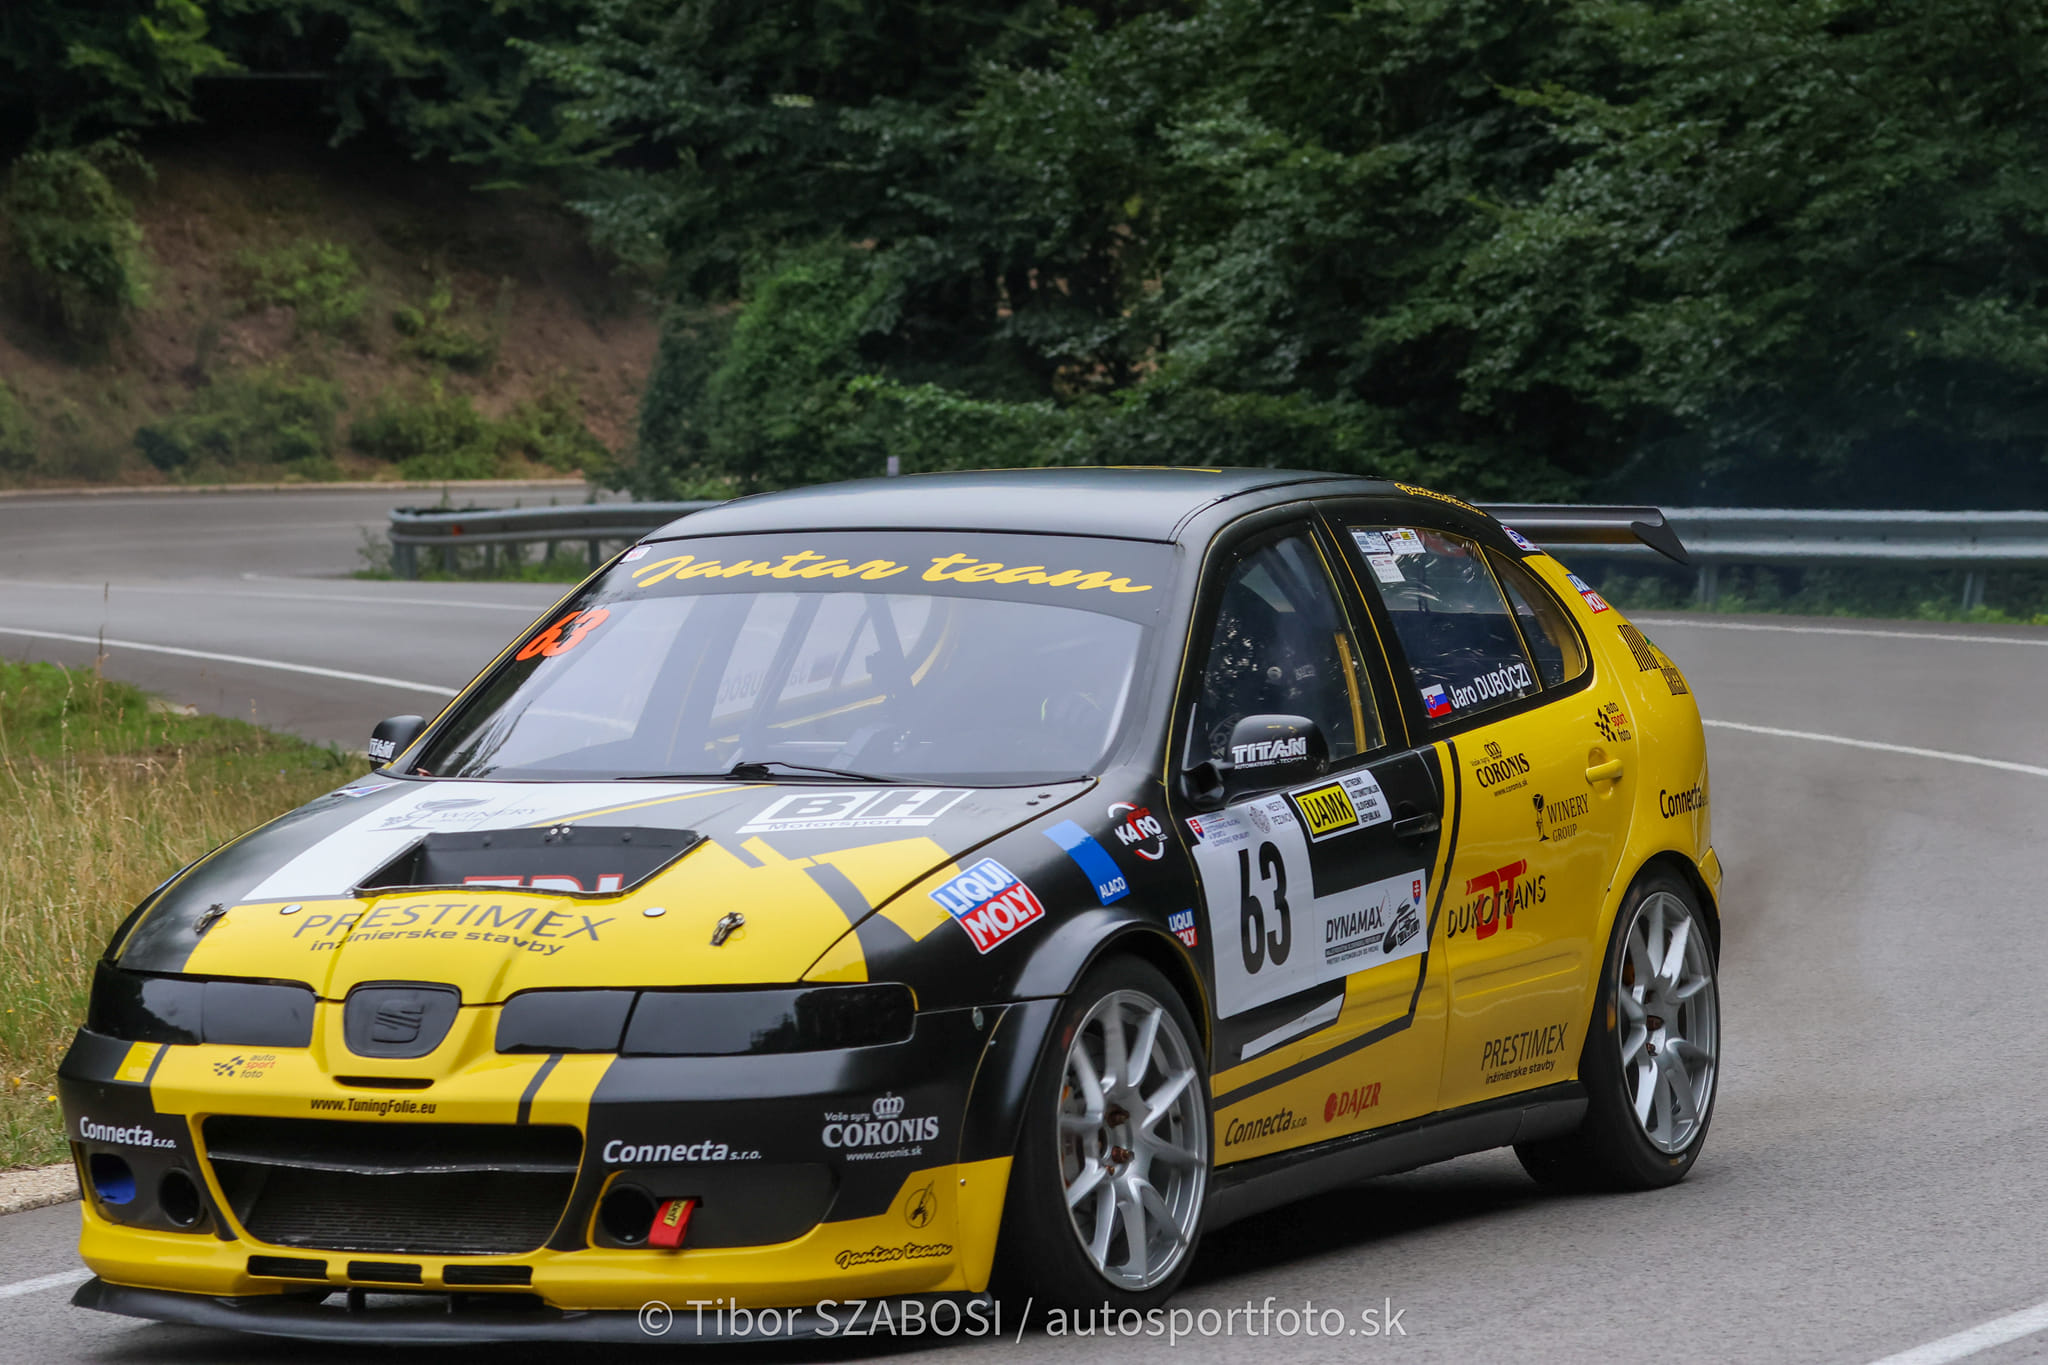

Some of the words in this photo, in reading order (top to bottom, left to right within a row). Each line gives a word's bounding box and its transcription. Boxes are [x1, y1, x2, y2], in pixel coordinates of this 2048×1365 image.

[632, 549, 908, 588] Jantar
[921, 552, 1154, 593] team
[515, 608, 610, 662] 63
[1232, 737, 1306, 764] TITAN
[1476, 753, 1530, 788] CORONIS
[1546, 793, 1589, 824] WINERY
[767, 818, 904, 831] Motorsport
[1552, 823, 1578, 842] GROUP
[936, 862, 1015, 917] LIQUI
[1100, 877, 1127, 899] ALACO
[964, 884, 1037, 947] MOLY
[1169, 911, 1194, 932] LIQUI
[1237, 841, 1292, 975] 63
[1447, 875, 1547, 938] DUKOTRANS
[292, 904, 616, 942] PRESTIMEX
[1326, 906, 1382, 943] DYNAMAX
[464, 930, 566, 957] stavby
[249, 1054, 276, 1062] auto
[1481, 1022, 1568, 1071] PRESTIMEX
[239, 1069, 264, 1079] foto
[245, 1060, 276, 1070] sport
[1528, 1058, 1555, 1075] stavby
[310, 1098, 437, 1116] www.TuningFolie.eu
[1337, 1082, 1381, 1119] DAJZR
[80, 1116, 153, 1147] Connecta
[822, 1116, 939, 1148] CORONIS
[1224, 1107, 1293, 1147] Connecta
[602, 1139, 729, 1163] Connecta
[729, 1150, 762, 1161] s.r.o.
[846, 1146, 923, 1161] www.coronis.sk
[835, 1245, 905, 1270] Jantar
[903, 1242, 953, 1259] team
